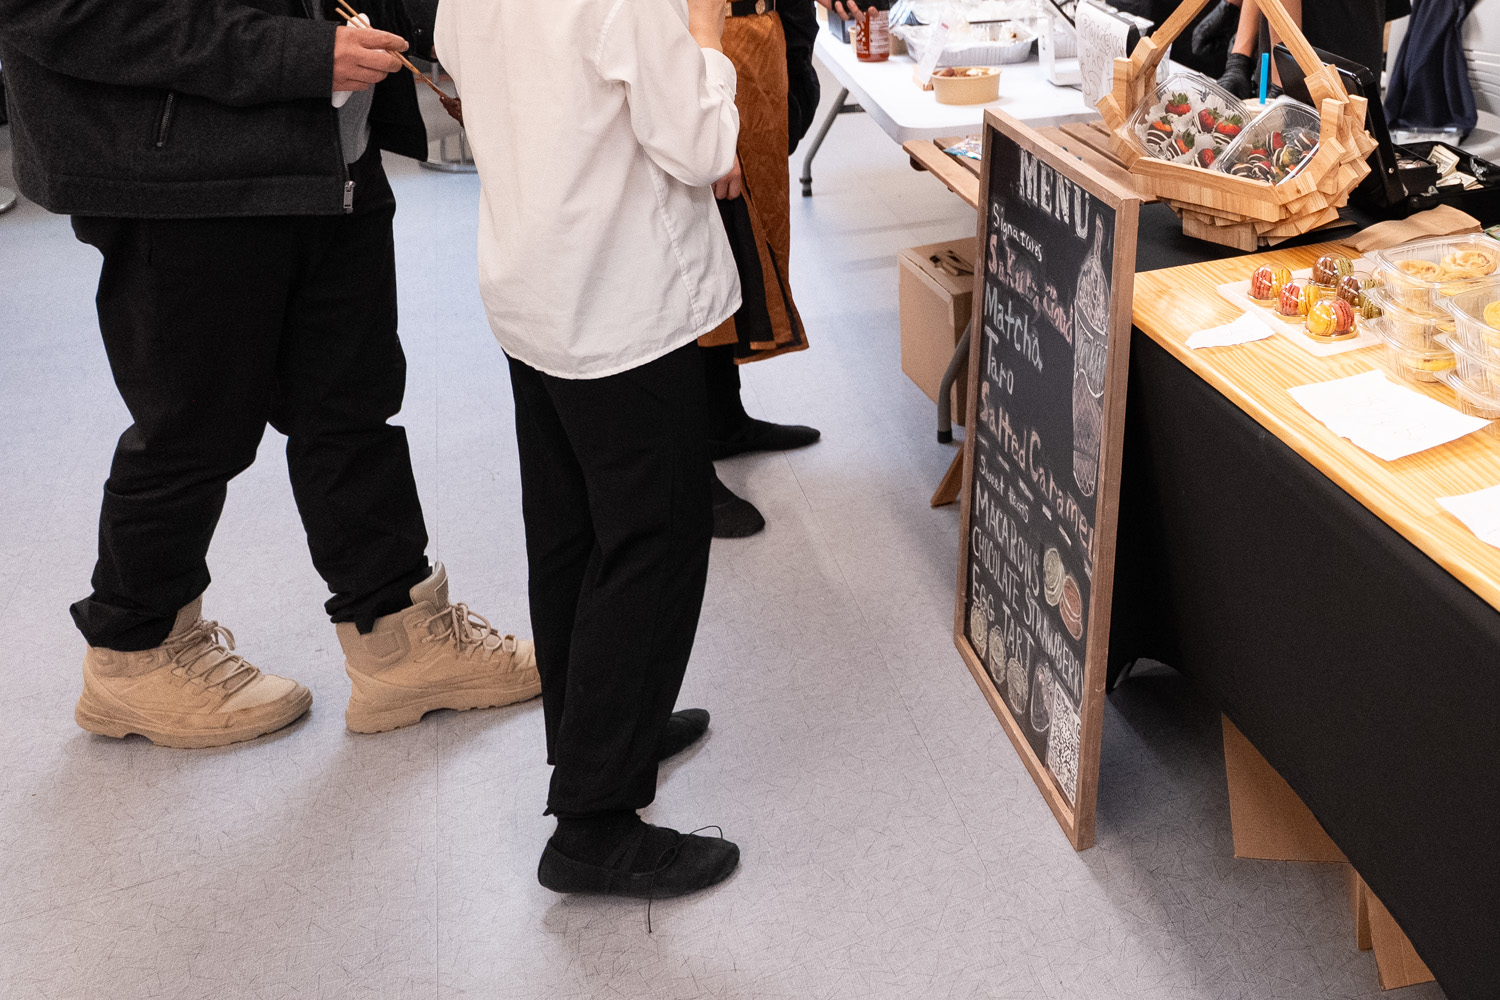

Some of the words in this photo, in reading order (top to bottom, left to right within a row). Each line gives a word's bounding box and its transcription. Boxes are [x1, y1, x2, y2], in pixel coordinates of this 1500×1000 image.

[992, 202, 1043, 262] Signatures
[1019, 149, 1090, 240] MENU
[984, 282, 1043, 373] Matcha
[984, 324, 1014, 395] Taro
[979, 381, 1027, 463] Salted
[1029, 427, 1096, 562] Caramel
[979, 454, 1005, 499] Sweet
[972, 526, 1020, 611] CHOCOLATE
[974, 480, 1040, 597] MACARONS
[971, 562, 996, 623] EGG
[1002, 601, 1035, 672] TART
